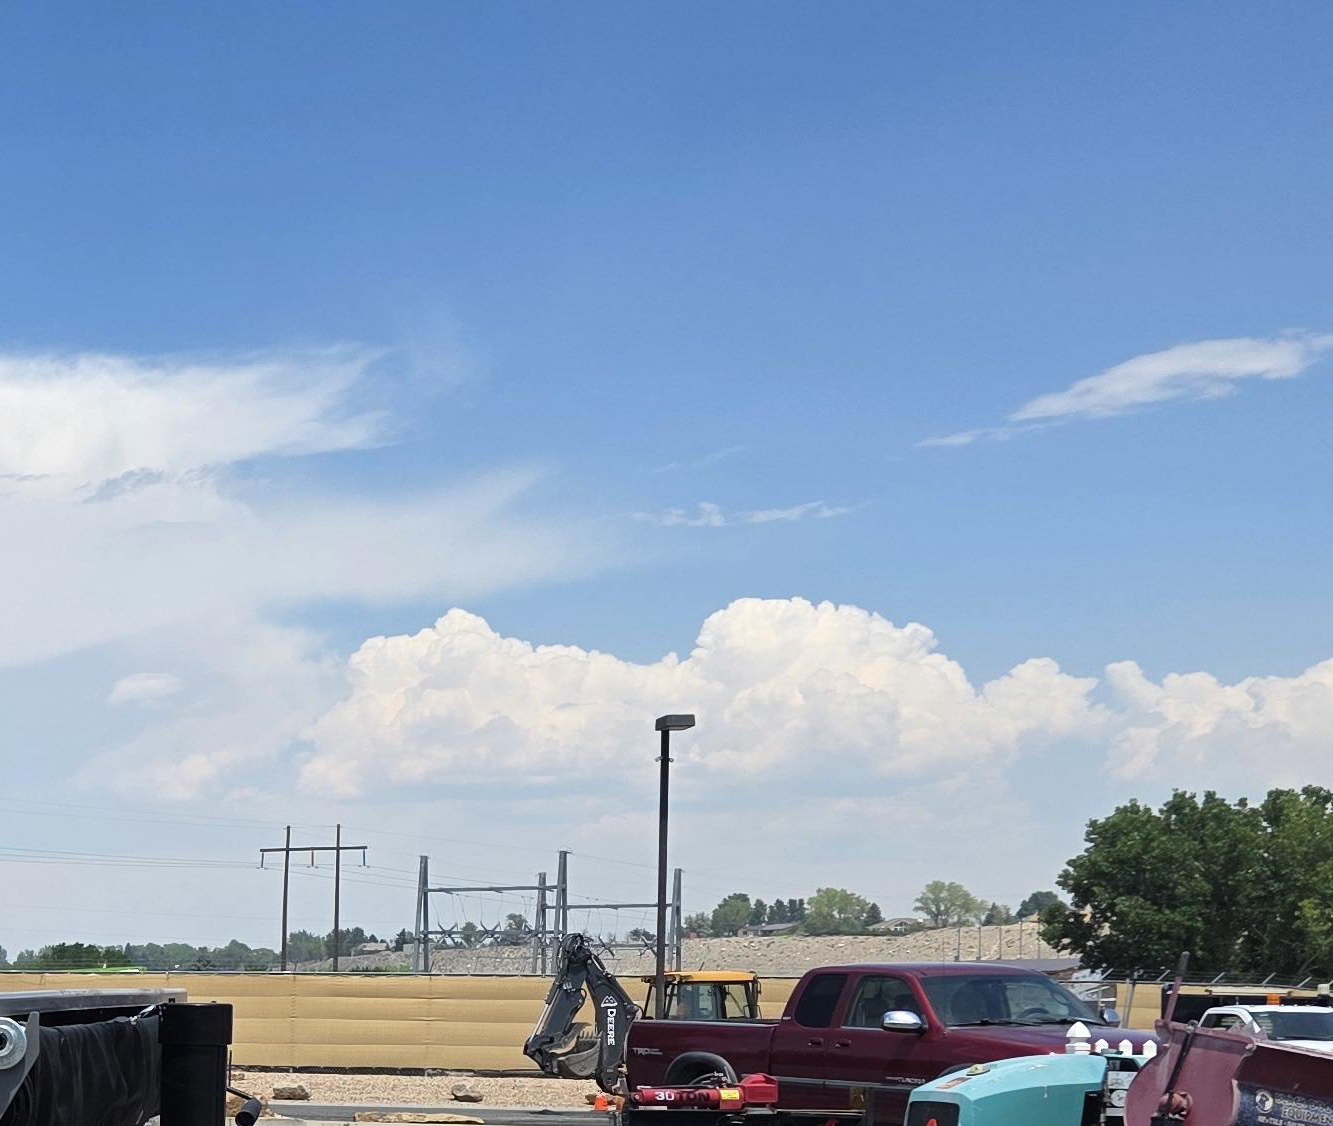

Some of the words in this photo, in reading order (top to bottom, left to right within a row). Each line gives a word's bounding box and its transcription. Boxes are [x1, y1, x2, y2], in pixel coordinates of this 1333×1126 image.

[607, 1008, 616, 1046] DEERE
[654, 1091, 674, 1100] 30
[677, 1091, 710, 1103] TON
